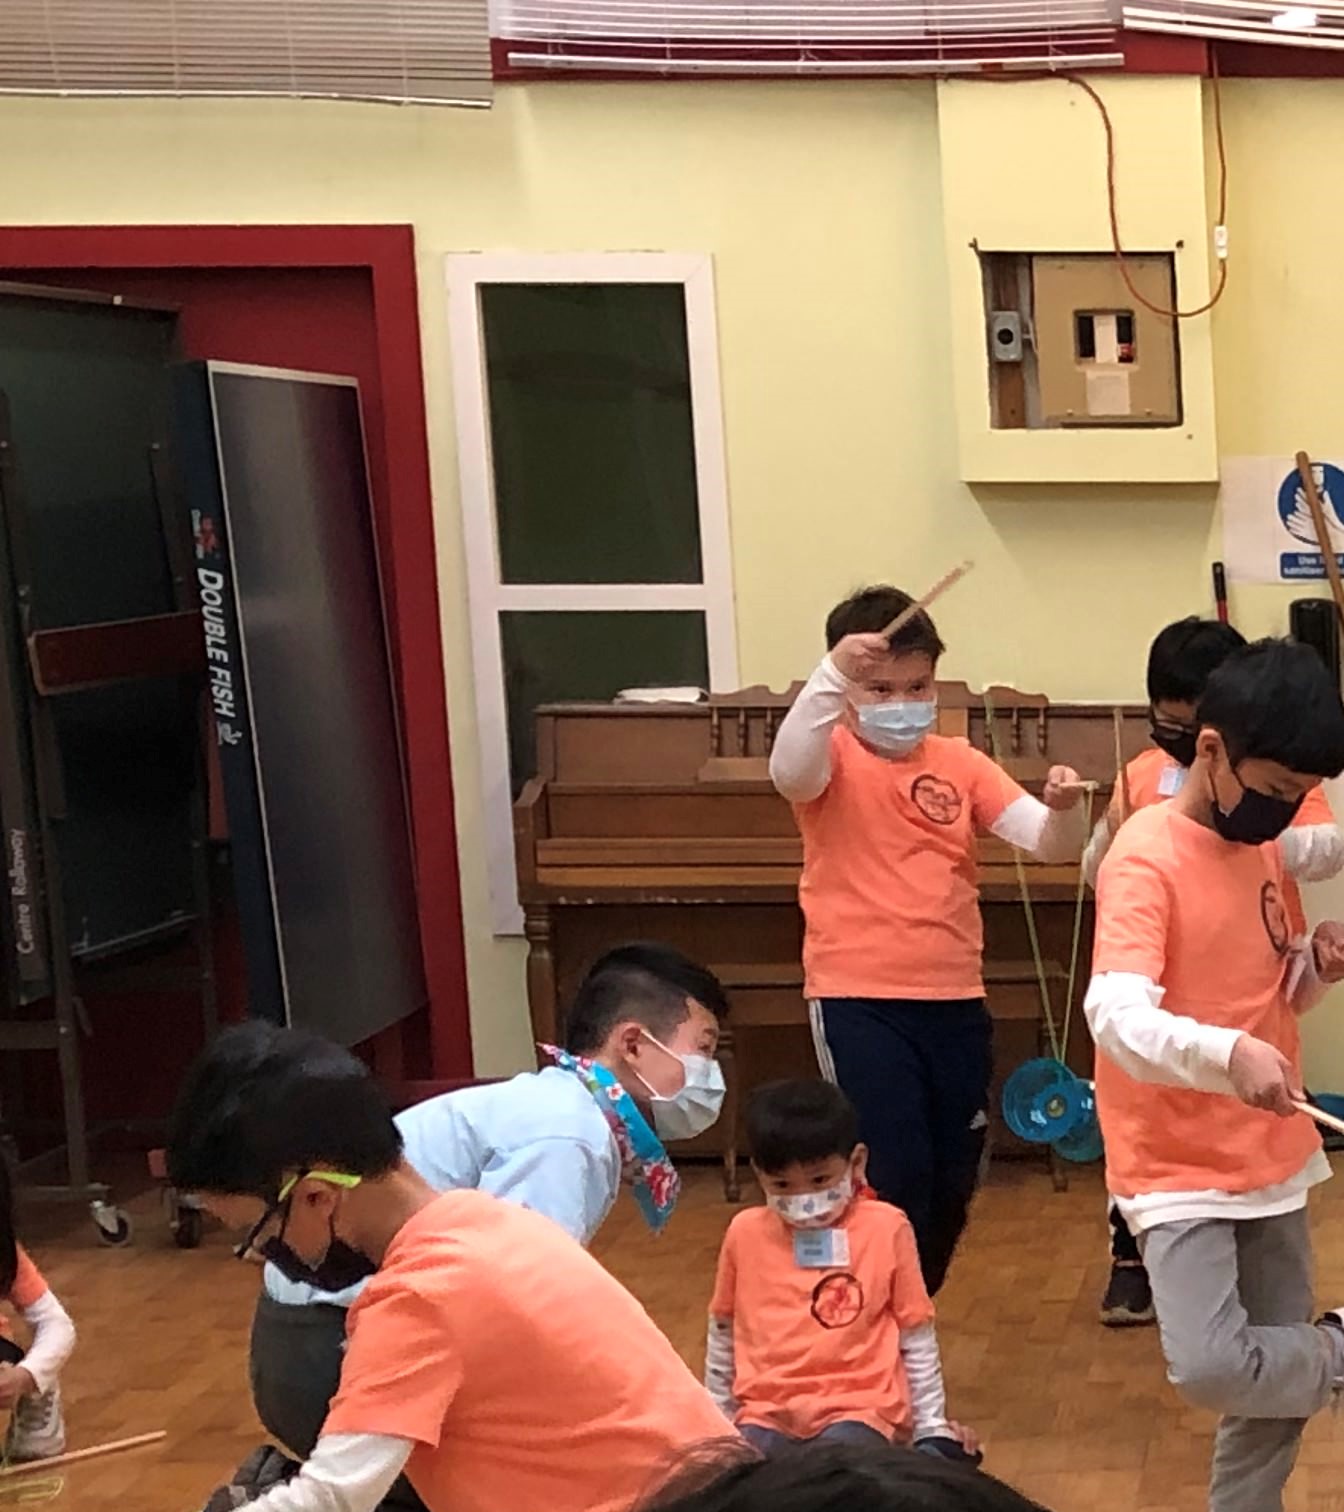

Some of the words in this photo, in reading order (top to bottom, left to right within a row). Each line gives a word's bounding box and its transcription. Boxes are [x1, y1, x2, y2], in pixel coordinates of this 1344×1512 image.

[197, 567, 229, 663] DOUBLE
[209, 665, 236, 718] FISH
[16, 903, 35, 954] Centre
